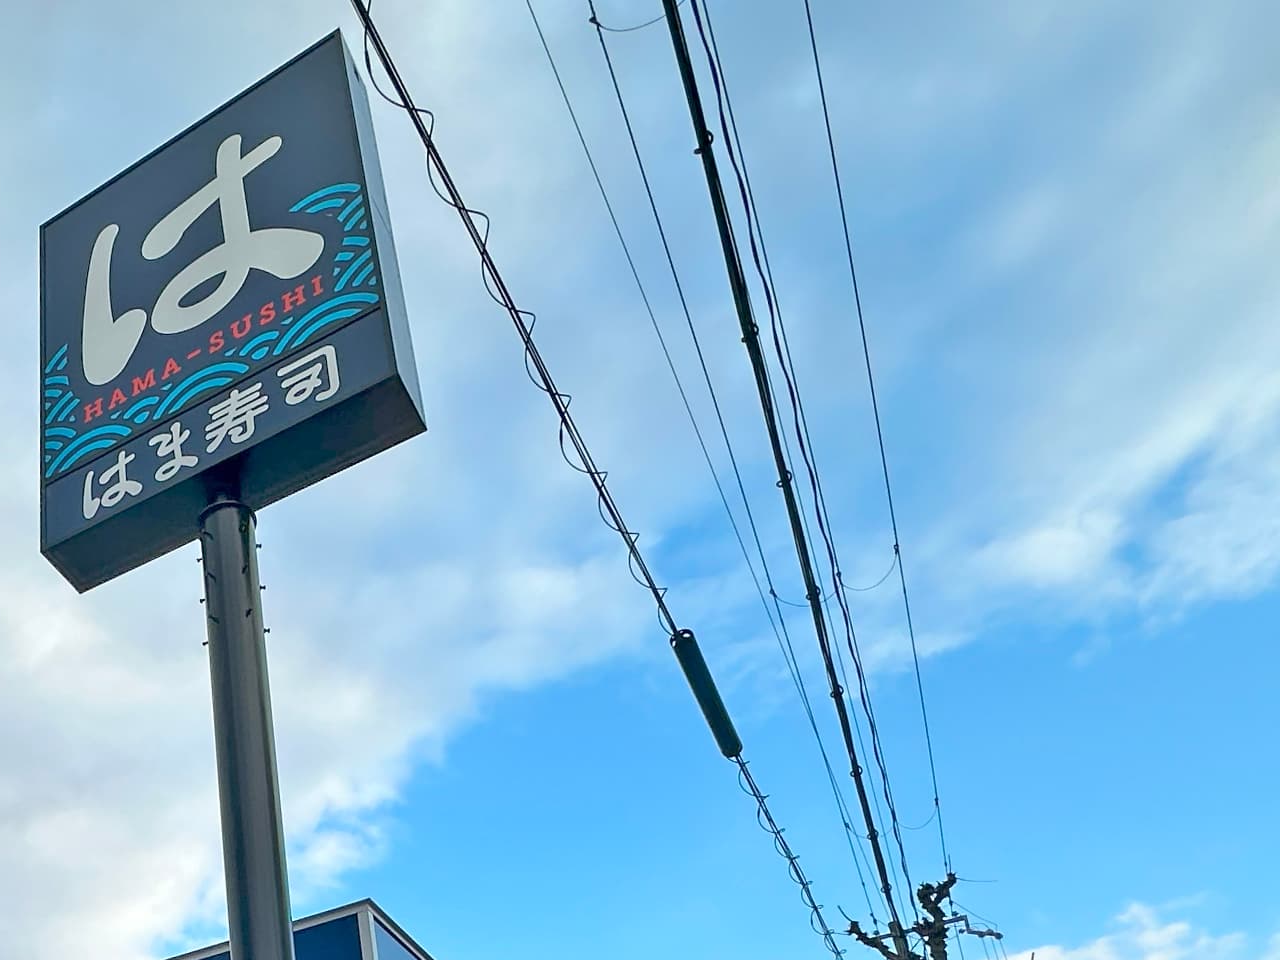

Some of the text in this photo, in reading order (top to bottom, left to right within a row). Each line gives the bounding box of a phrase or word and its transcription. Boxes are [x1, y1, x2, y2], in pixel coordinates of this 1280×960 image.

[81, 133, 324, 385] は
[82, 344, 341, 520] はま寿司
[83, 276, 325, 423] HAMA-SUSHI
